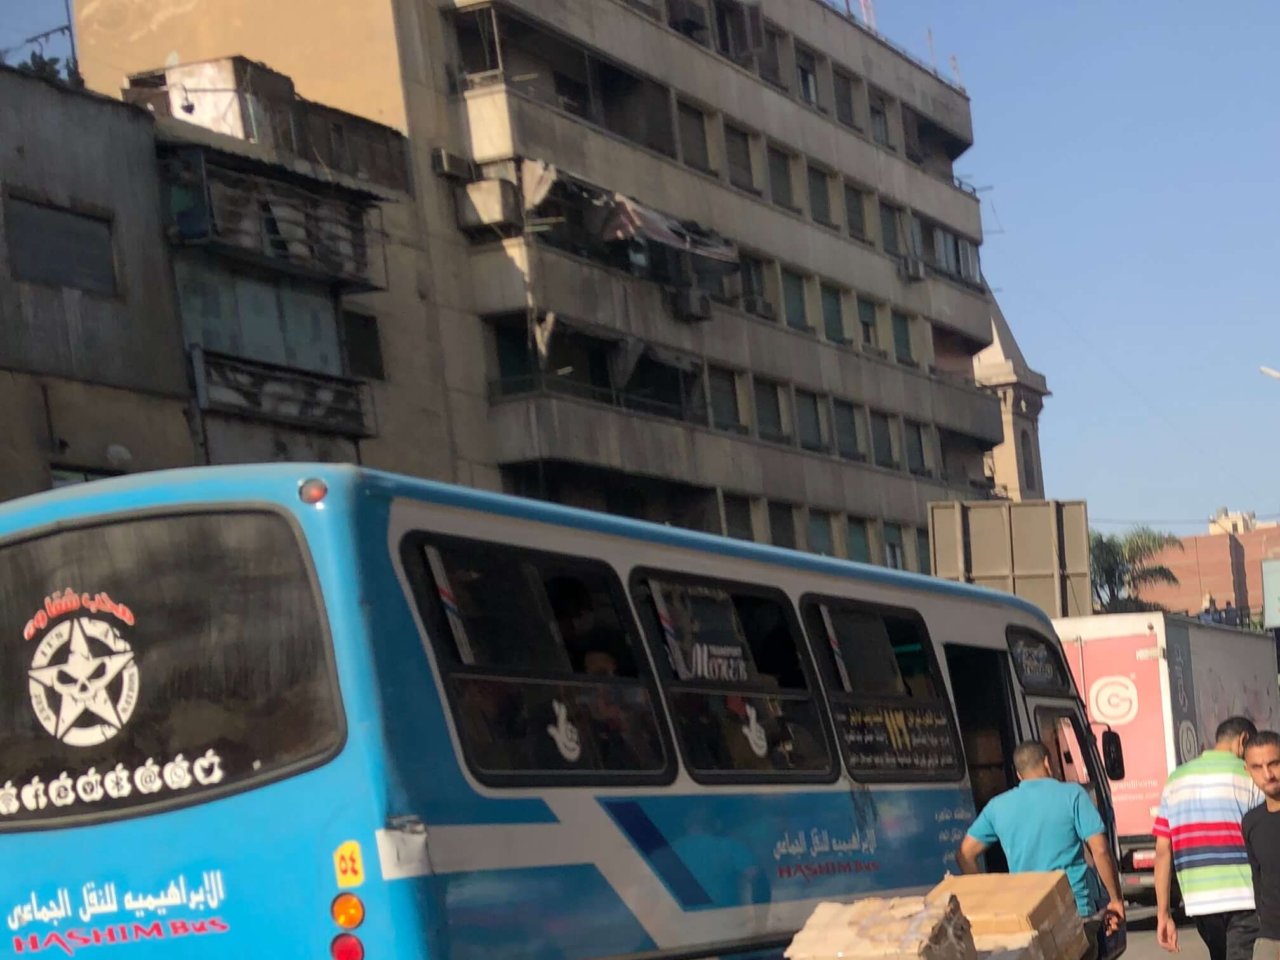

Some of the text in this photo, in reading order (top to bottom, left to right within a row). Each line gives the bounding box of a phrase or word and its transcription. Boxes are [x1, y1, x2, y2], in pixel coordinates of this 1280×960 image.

[79, 881, 118, 922] للنقل
[14, 917, 229, 956] HASHIM Bus
